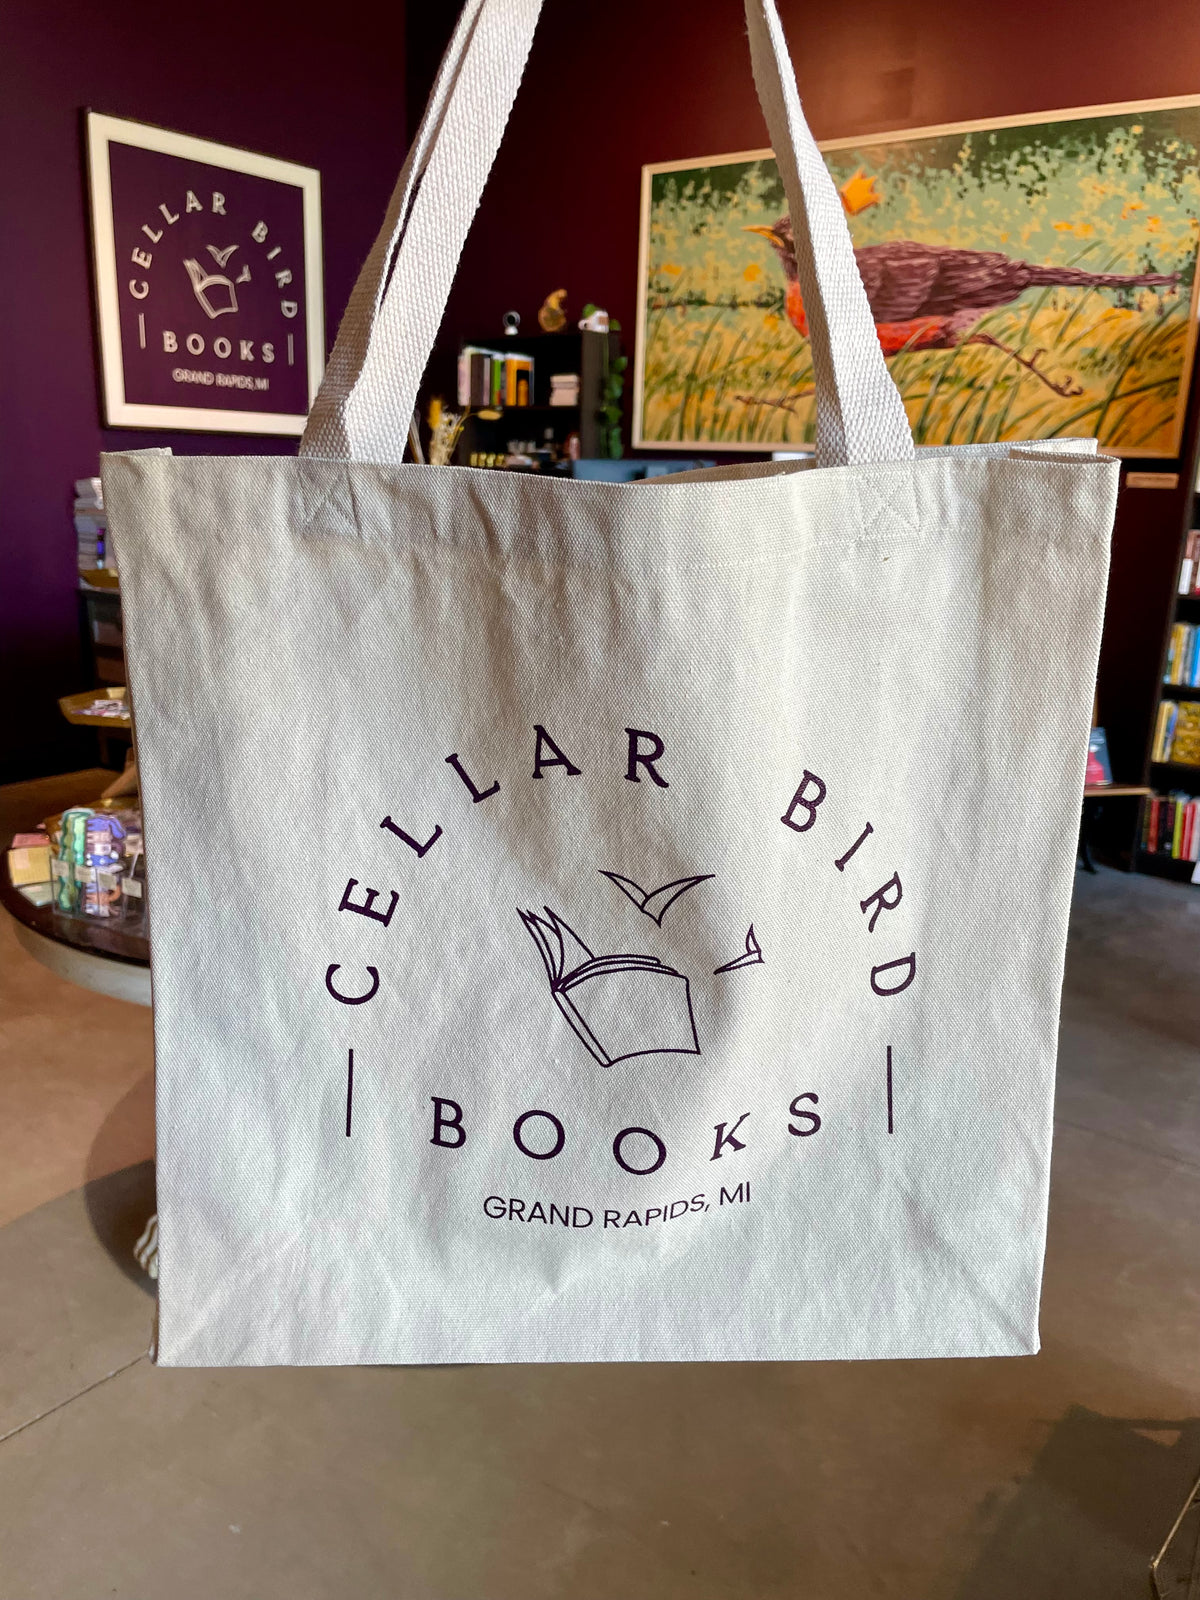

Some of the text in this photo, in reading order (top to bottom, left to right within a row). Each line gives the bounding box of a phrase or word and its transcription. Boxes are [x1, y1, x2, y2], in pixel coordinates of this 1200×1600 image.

[129, 190, 298, 318] CELLAR BIRD
[162, 330, 275, 363] BOOKS
[172, 368, 215, 386] GRAND
[325, 724, 916, 1005] CELLAR BIRD
[429, 1092, 822, 1176] BOOKS
[483, 1180, 751, 1229] GRAND RAPIDS, MI
